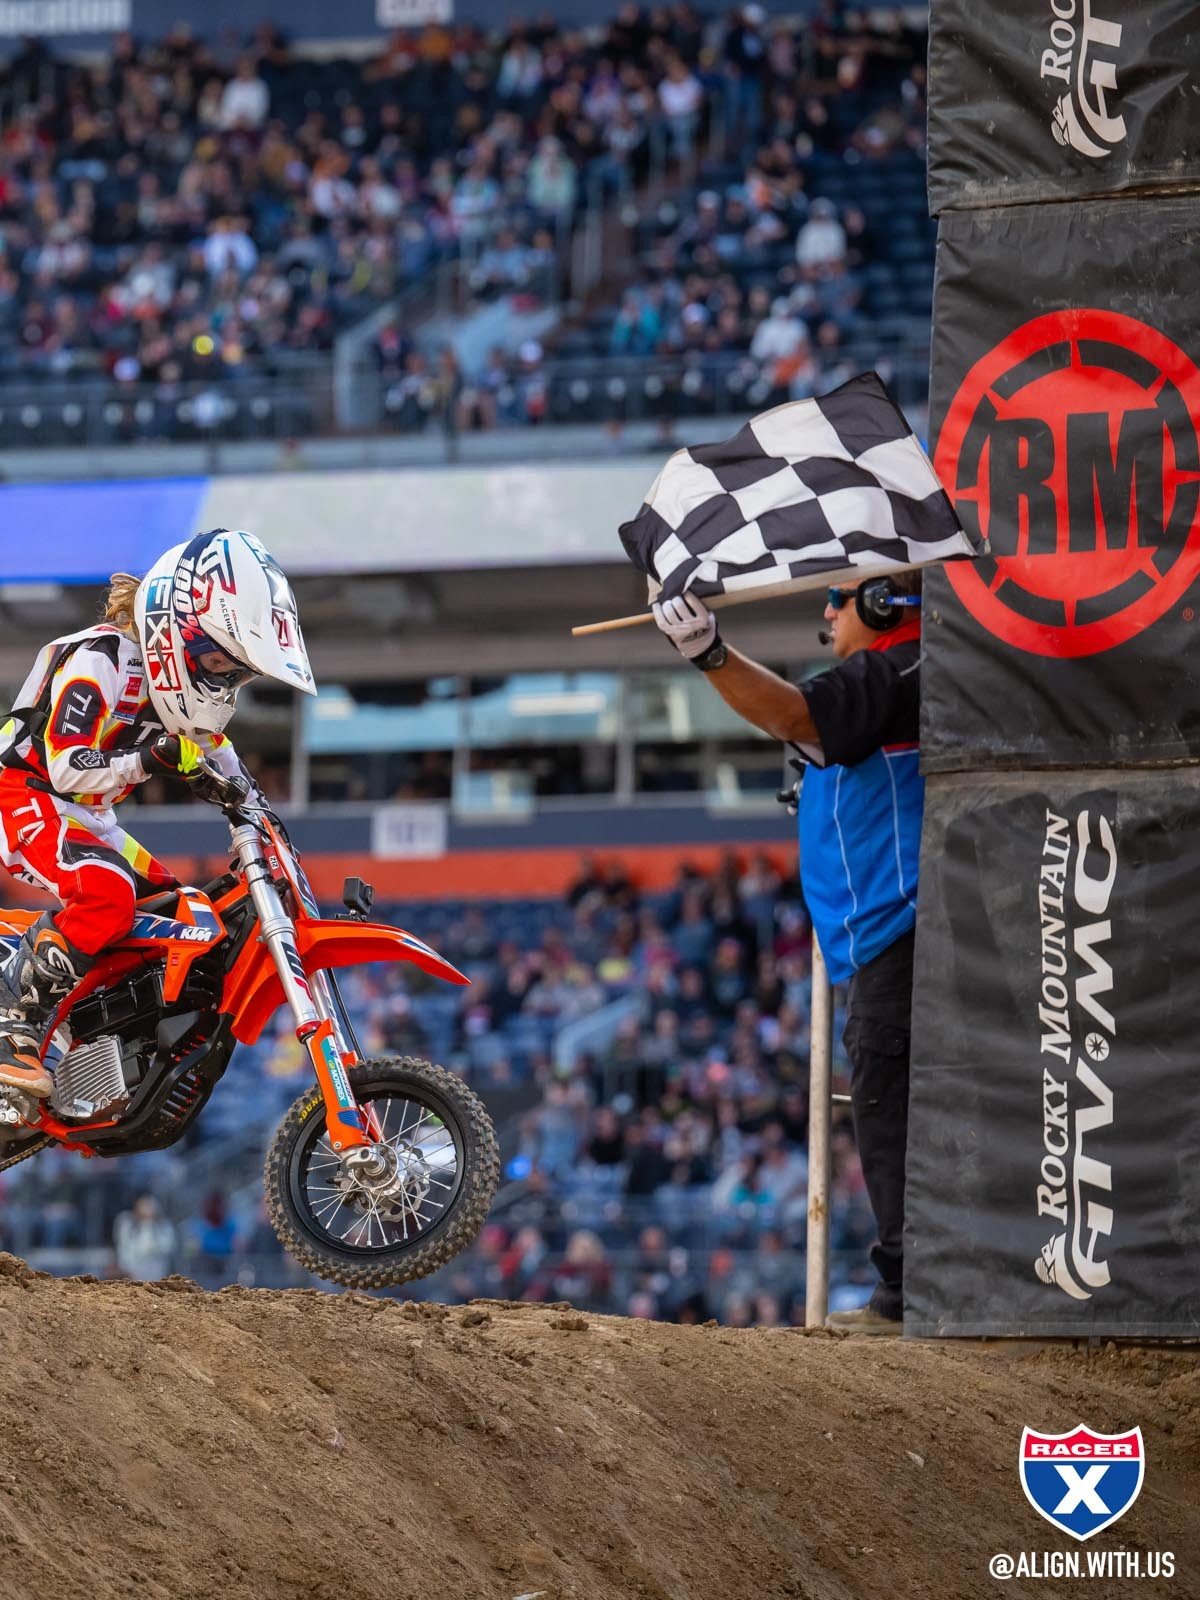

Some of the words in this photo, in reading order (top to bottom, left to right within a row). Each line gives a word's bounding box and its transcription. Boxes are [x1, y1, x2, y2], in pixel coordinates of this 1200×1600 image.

[988, 407, 1165, 557] RM
[173, 556, 205, 641] 100%
[179, 926, 213, 941] KTM
[1038, 808, 1071, 1064] MOUNTAIN
[330, 1069, 346, 1101] MOTOREX
[1037, 1068, 1069, 1225] ROCKY
